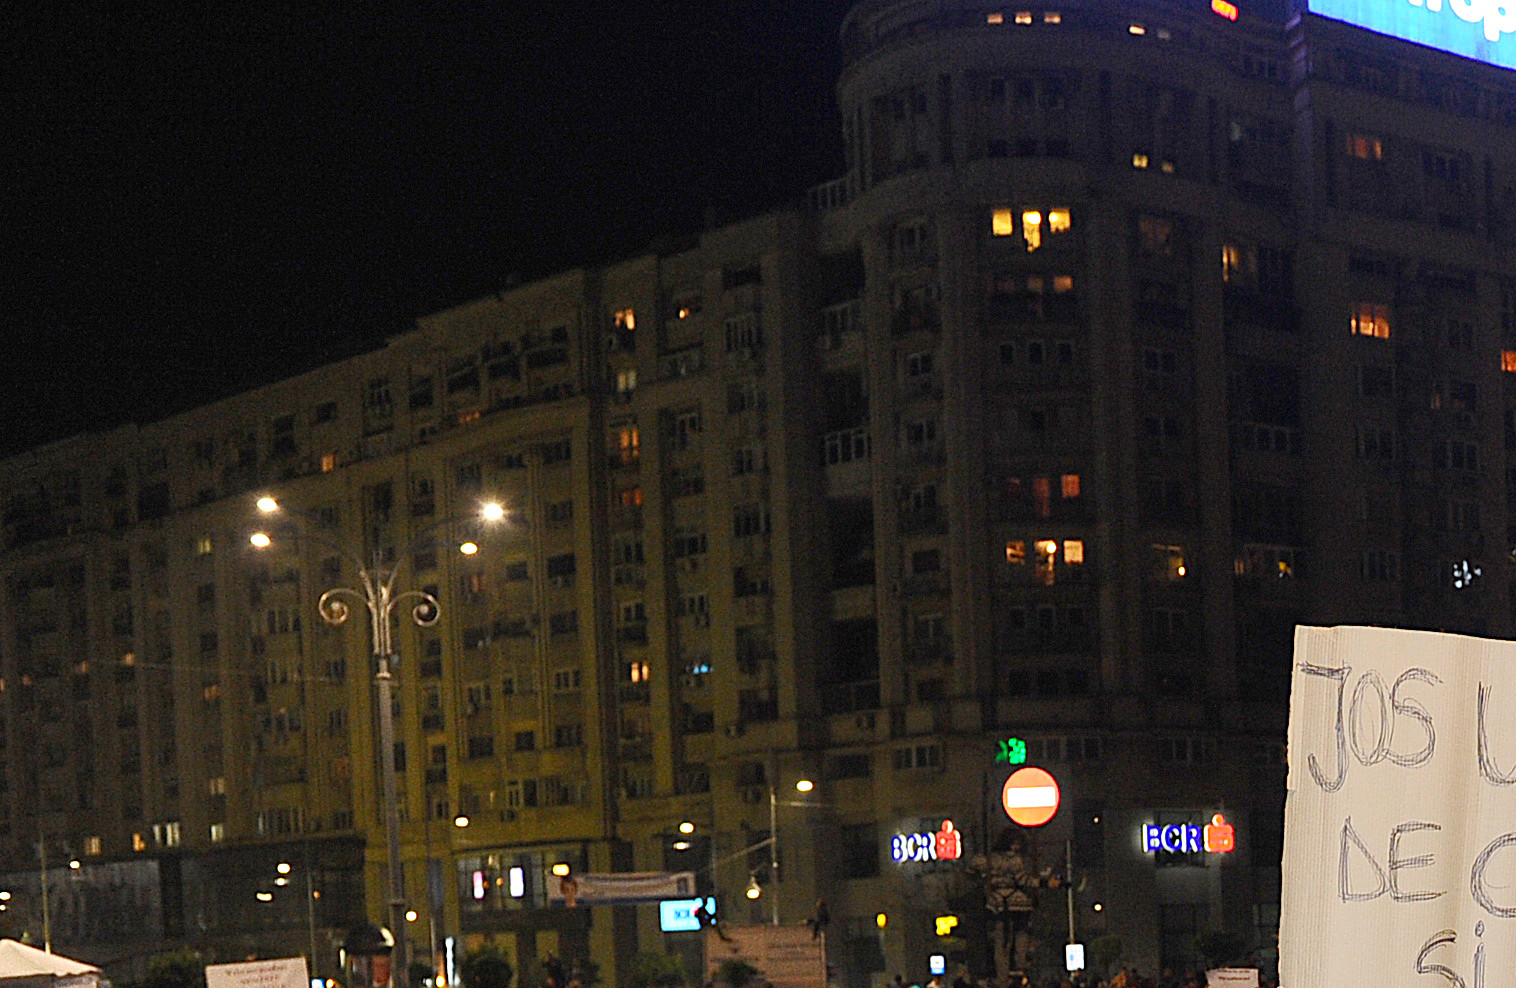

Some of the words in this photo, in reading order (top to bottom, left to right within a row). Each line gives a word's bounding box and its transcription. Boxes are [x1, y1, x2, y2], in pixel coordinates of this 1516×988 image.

[1299, 661, 1444, 792] JOS
[891, 832, 937, 863] BCR
[1142, 823, 1203, 854] BCR
[1339, 816, 1447, 902] DE
